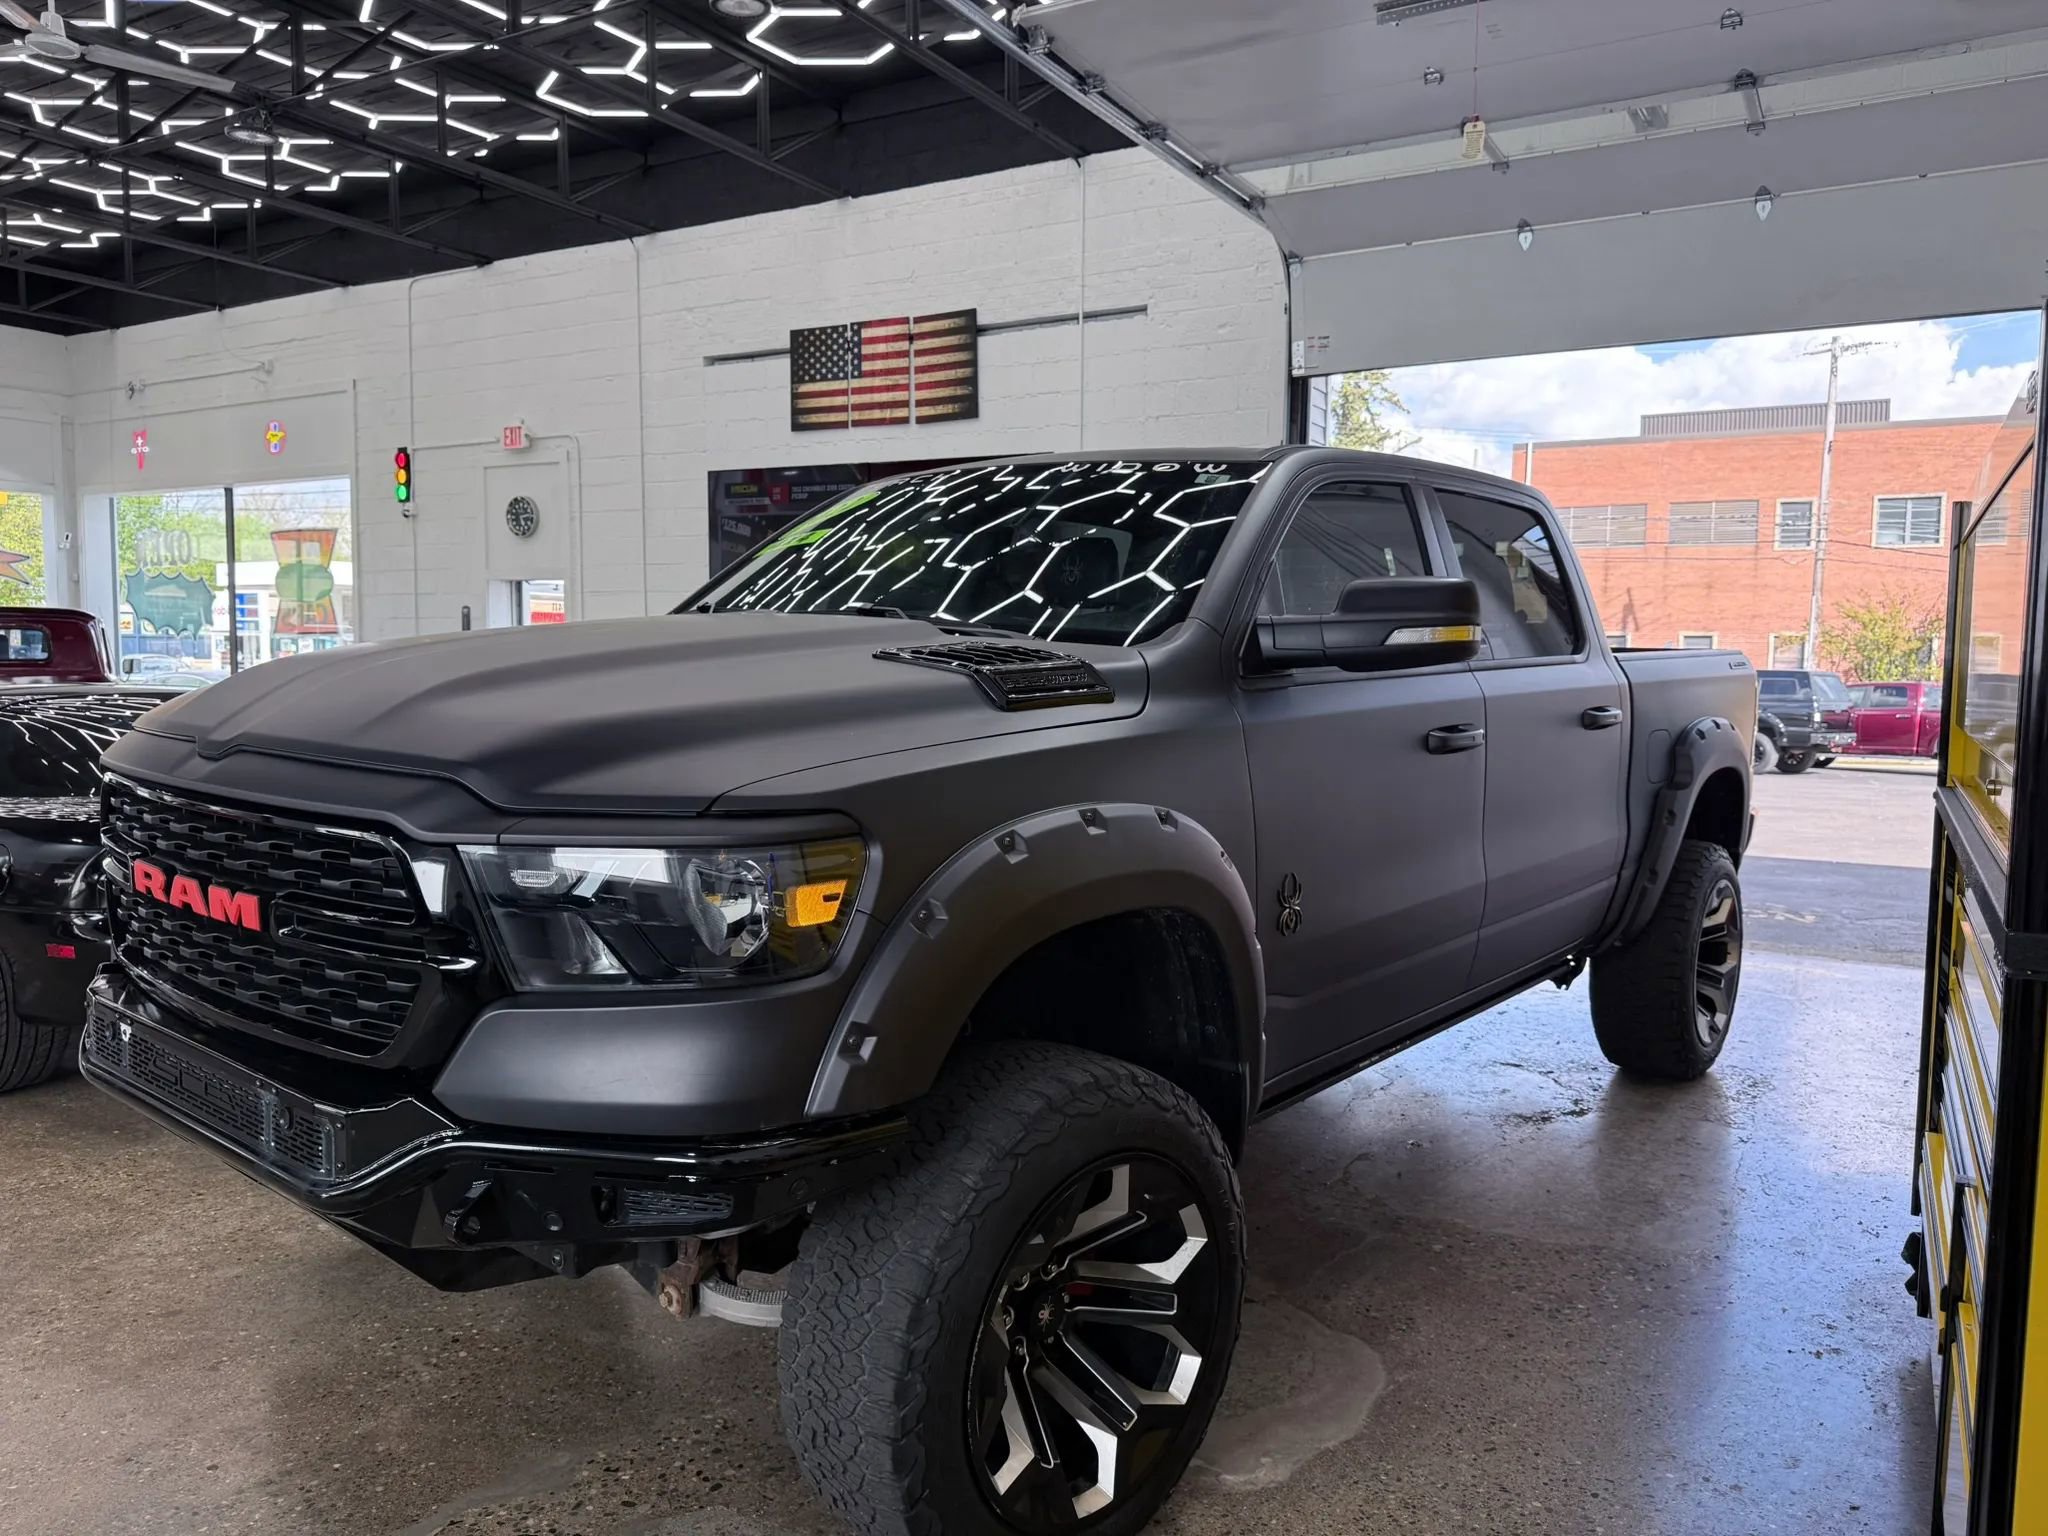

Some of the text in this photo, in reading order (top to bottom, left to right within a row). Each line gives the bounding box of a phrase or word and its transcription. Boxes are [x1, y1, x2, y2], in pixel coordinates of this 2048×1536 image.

[503, 426, 522, 448] EXIT
[130, 446, 150, 455] GTO
[133, 858, 262, 932] RAM
